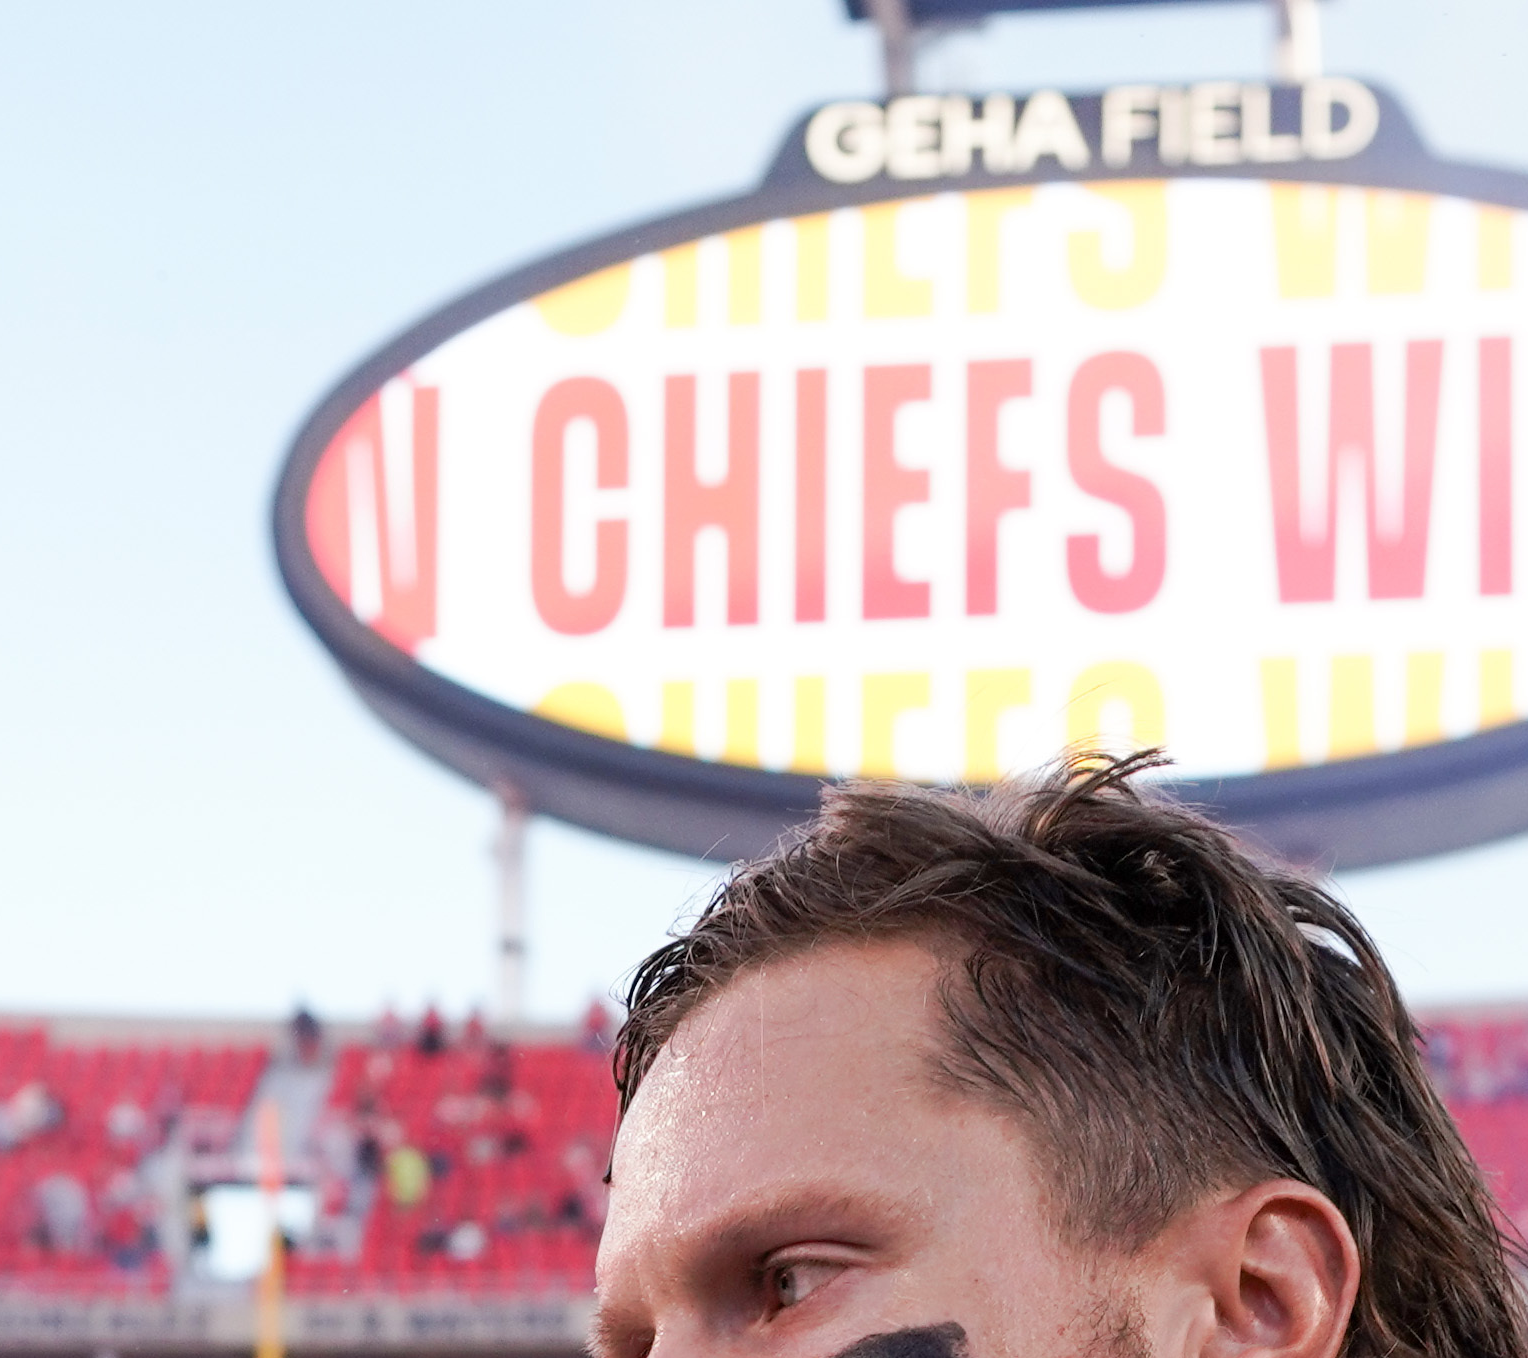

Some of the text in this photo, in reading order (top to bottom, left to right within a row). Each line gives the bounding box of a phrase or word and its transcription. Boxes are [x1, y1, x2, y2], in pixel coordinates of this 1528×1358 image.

[804, 77, 1380, 183] GEHA FIELD
[531, 350, 1168, 637] CHIEFS
